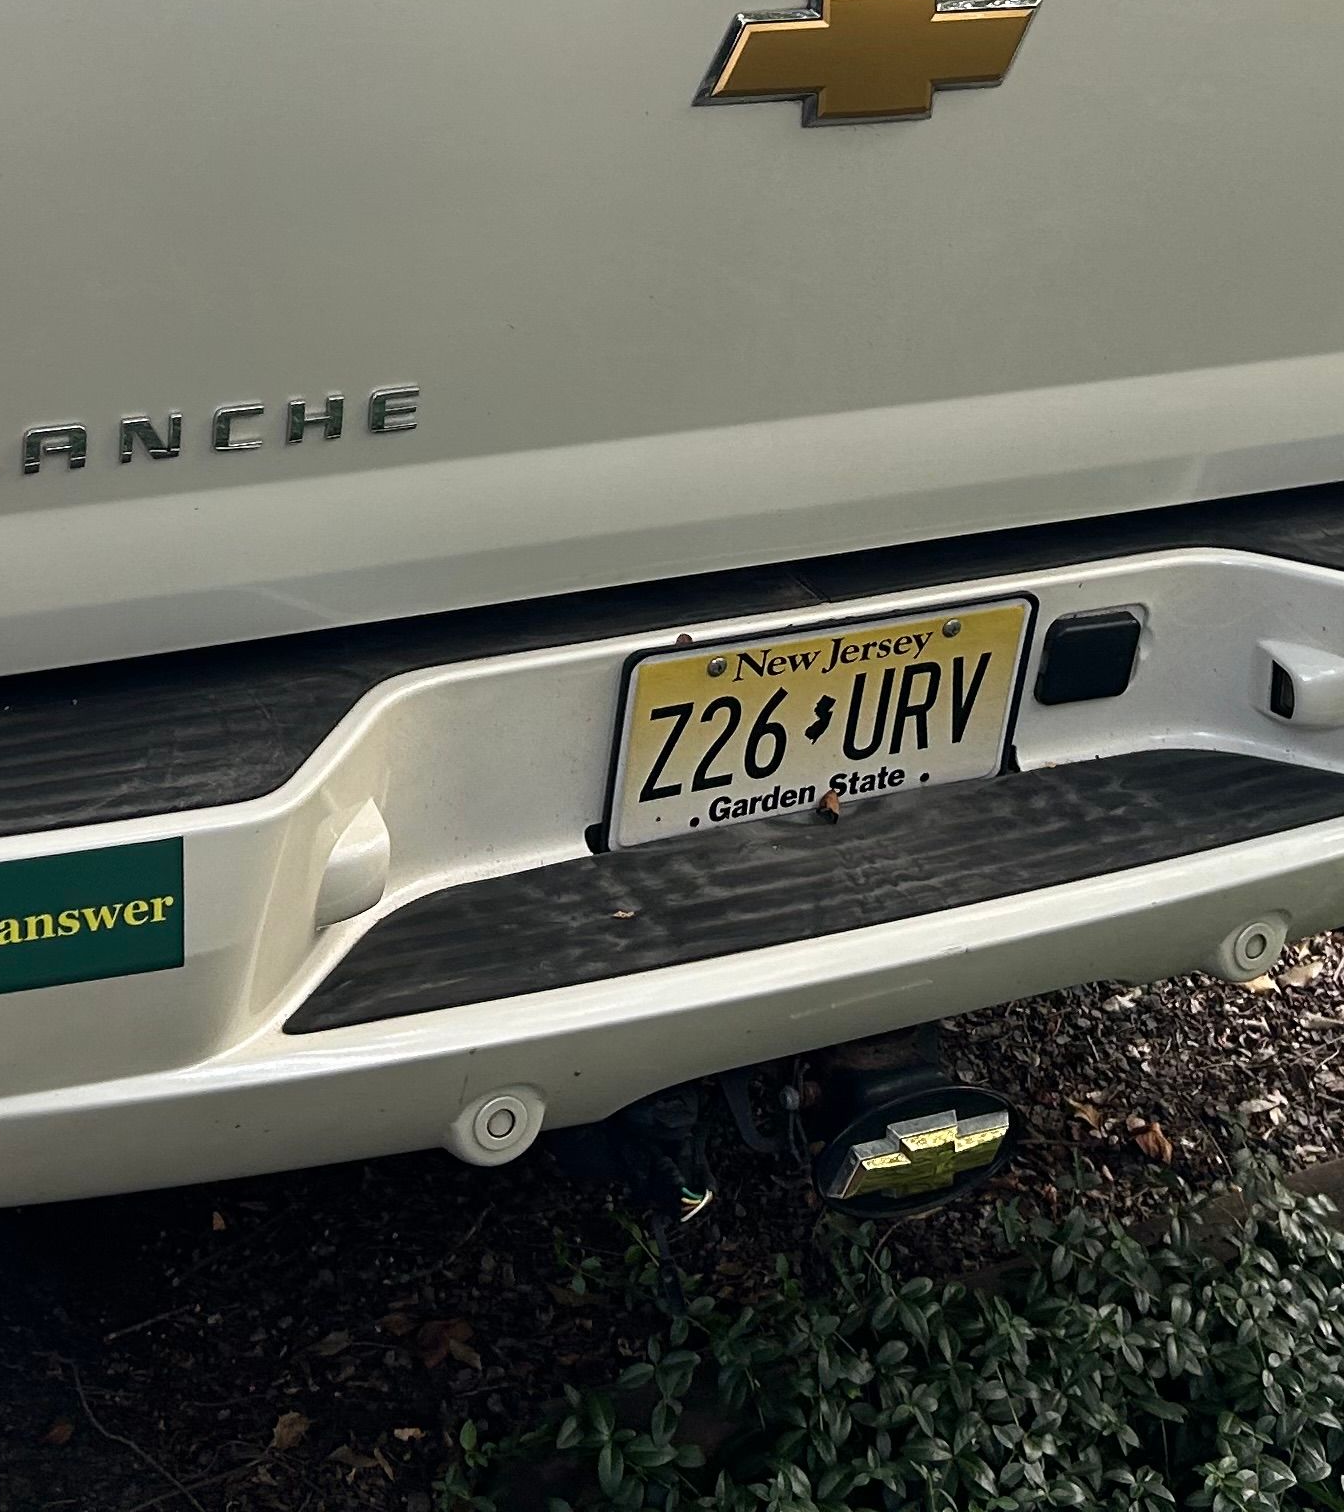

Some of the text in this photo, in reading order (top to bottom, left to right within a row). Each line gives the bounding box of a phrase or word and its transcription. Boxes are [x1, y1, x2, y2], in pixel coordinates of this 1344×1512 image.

[733, 631, 934, 682] New Jersey
[639, 652, 993, 803] Z26 URV
[708, 766, 906, 823] Garden State
